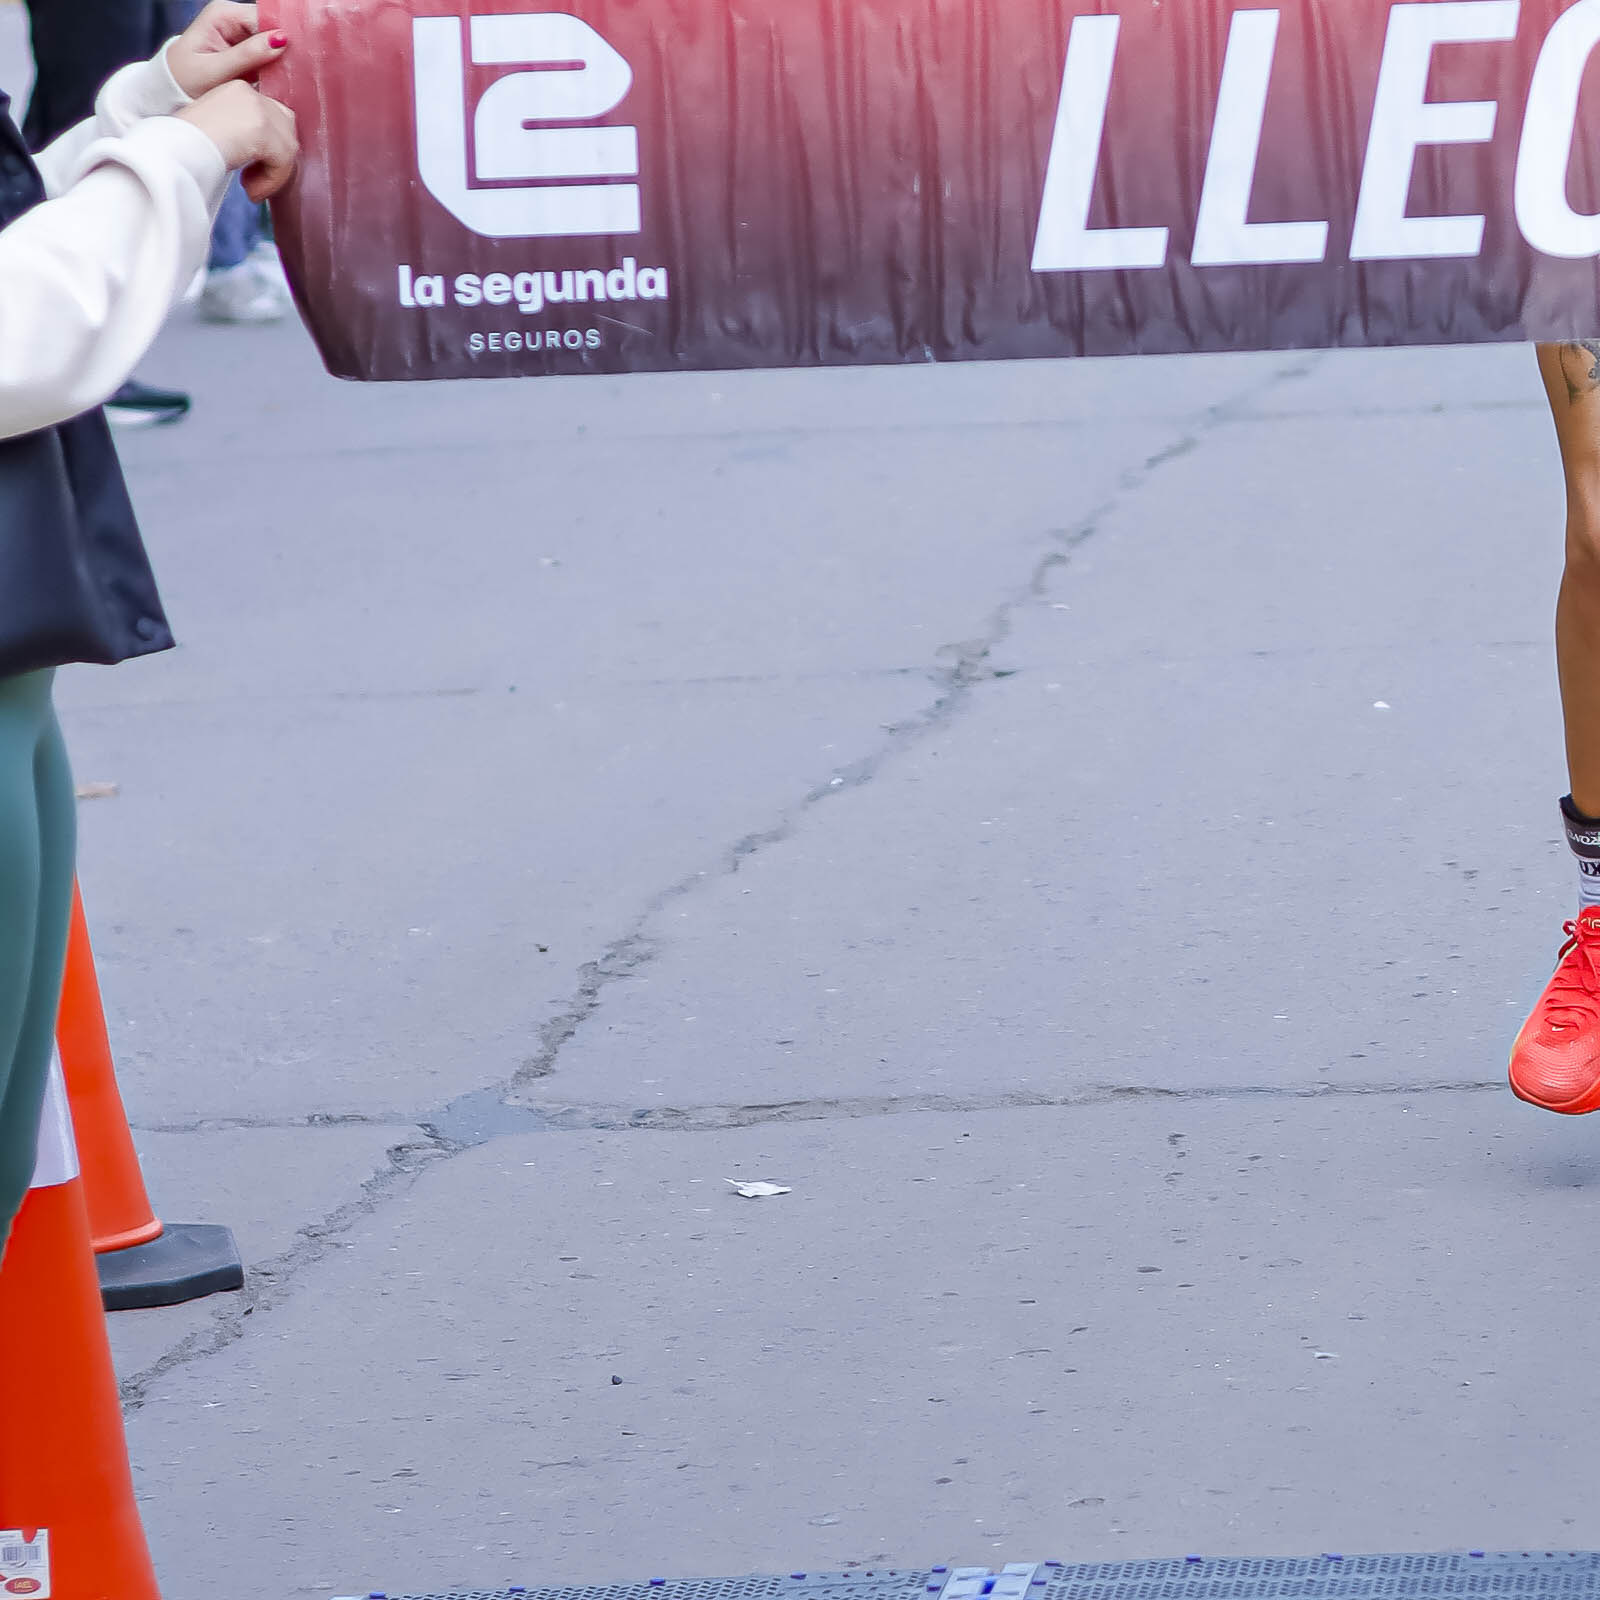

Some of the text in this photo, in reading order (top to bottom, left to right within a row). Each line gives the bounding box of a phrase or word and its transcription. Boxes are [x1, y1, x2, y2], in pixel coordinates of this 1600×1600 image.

[399, 256, 668, 314] la segunda
[468, 328, 602, 352] SEGUROS
